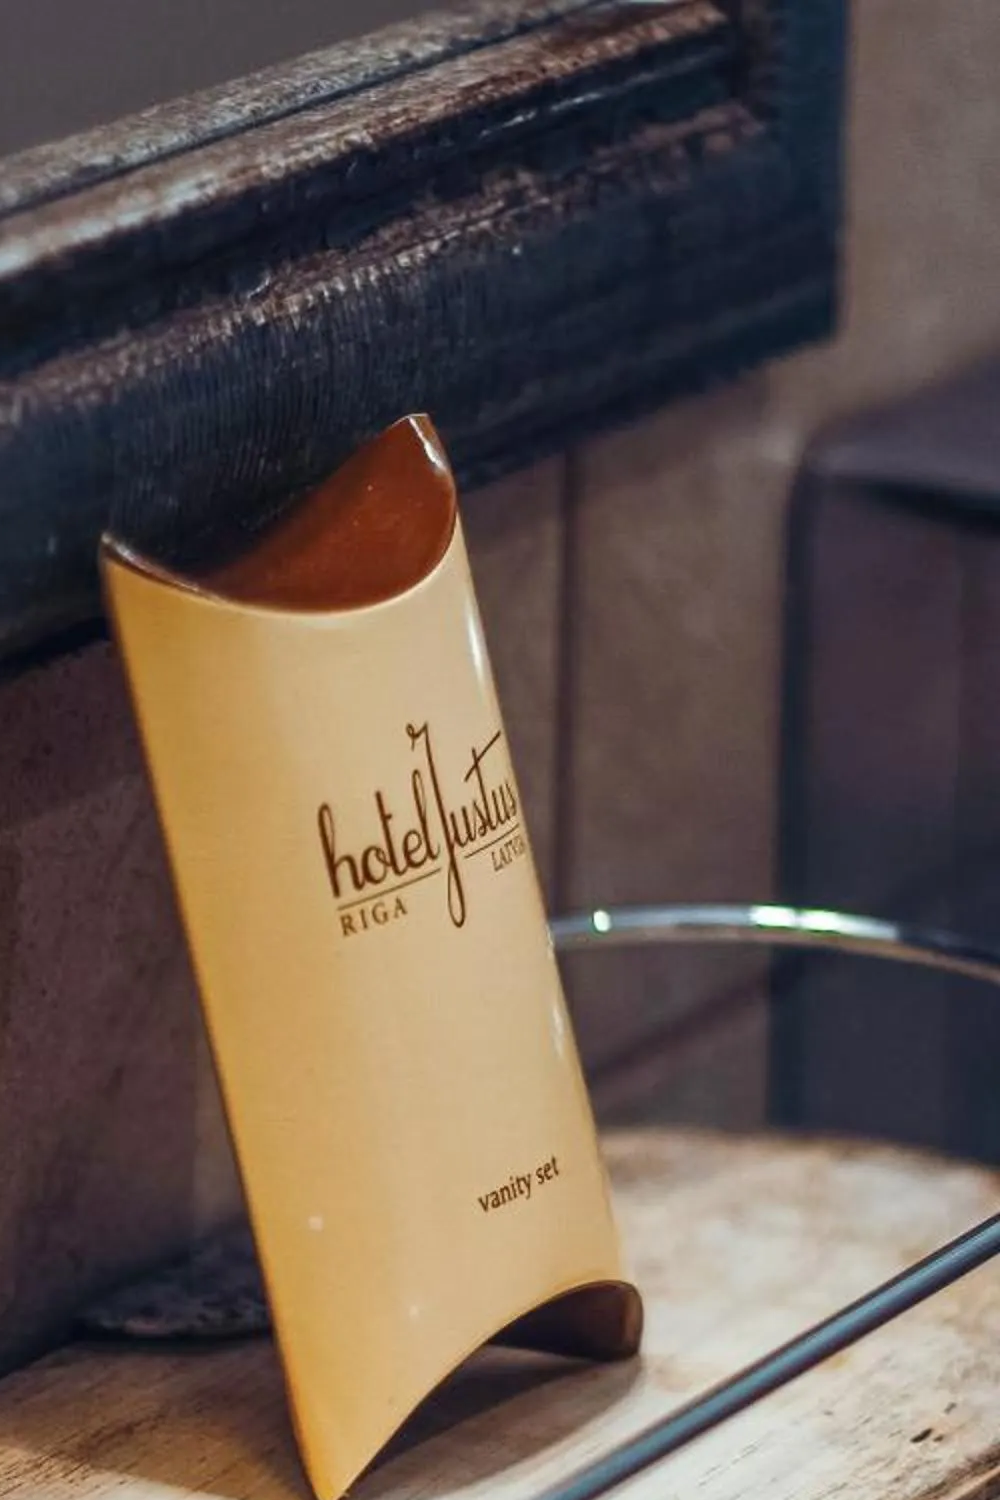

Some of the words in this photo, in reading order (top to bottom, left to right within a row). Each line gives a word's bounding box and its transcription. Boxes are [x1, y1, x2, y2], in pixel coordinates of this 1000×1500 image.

[317, 769, 441, 898] hotel
[405, 720, 518, 929] Justus
[340, 895, 409, 937] RIGA
[477, 1172, 532, 1213] vanity
[534, 1153, 560, 1186] set
